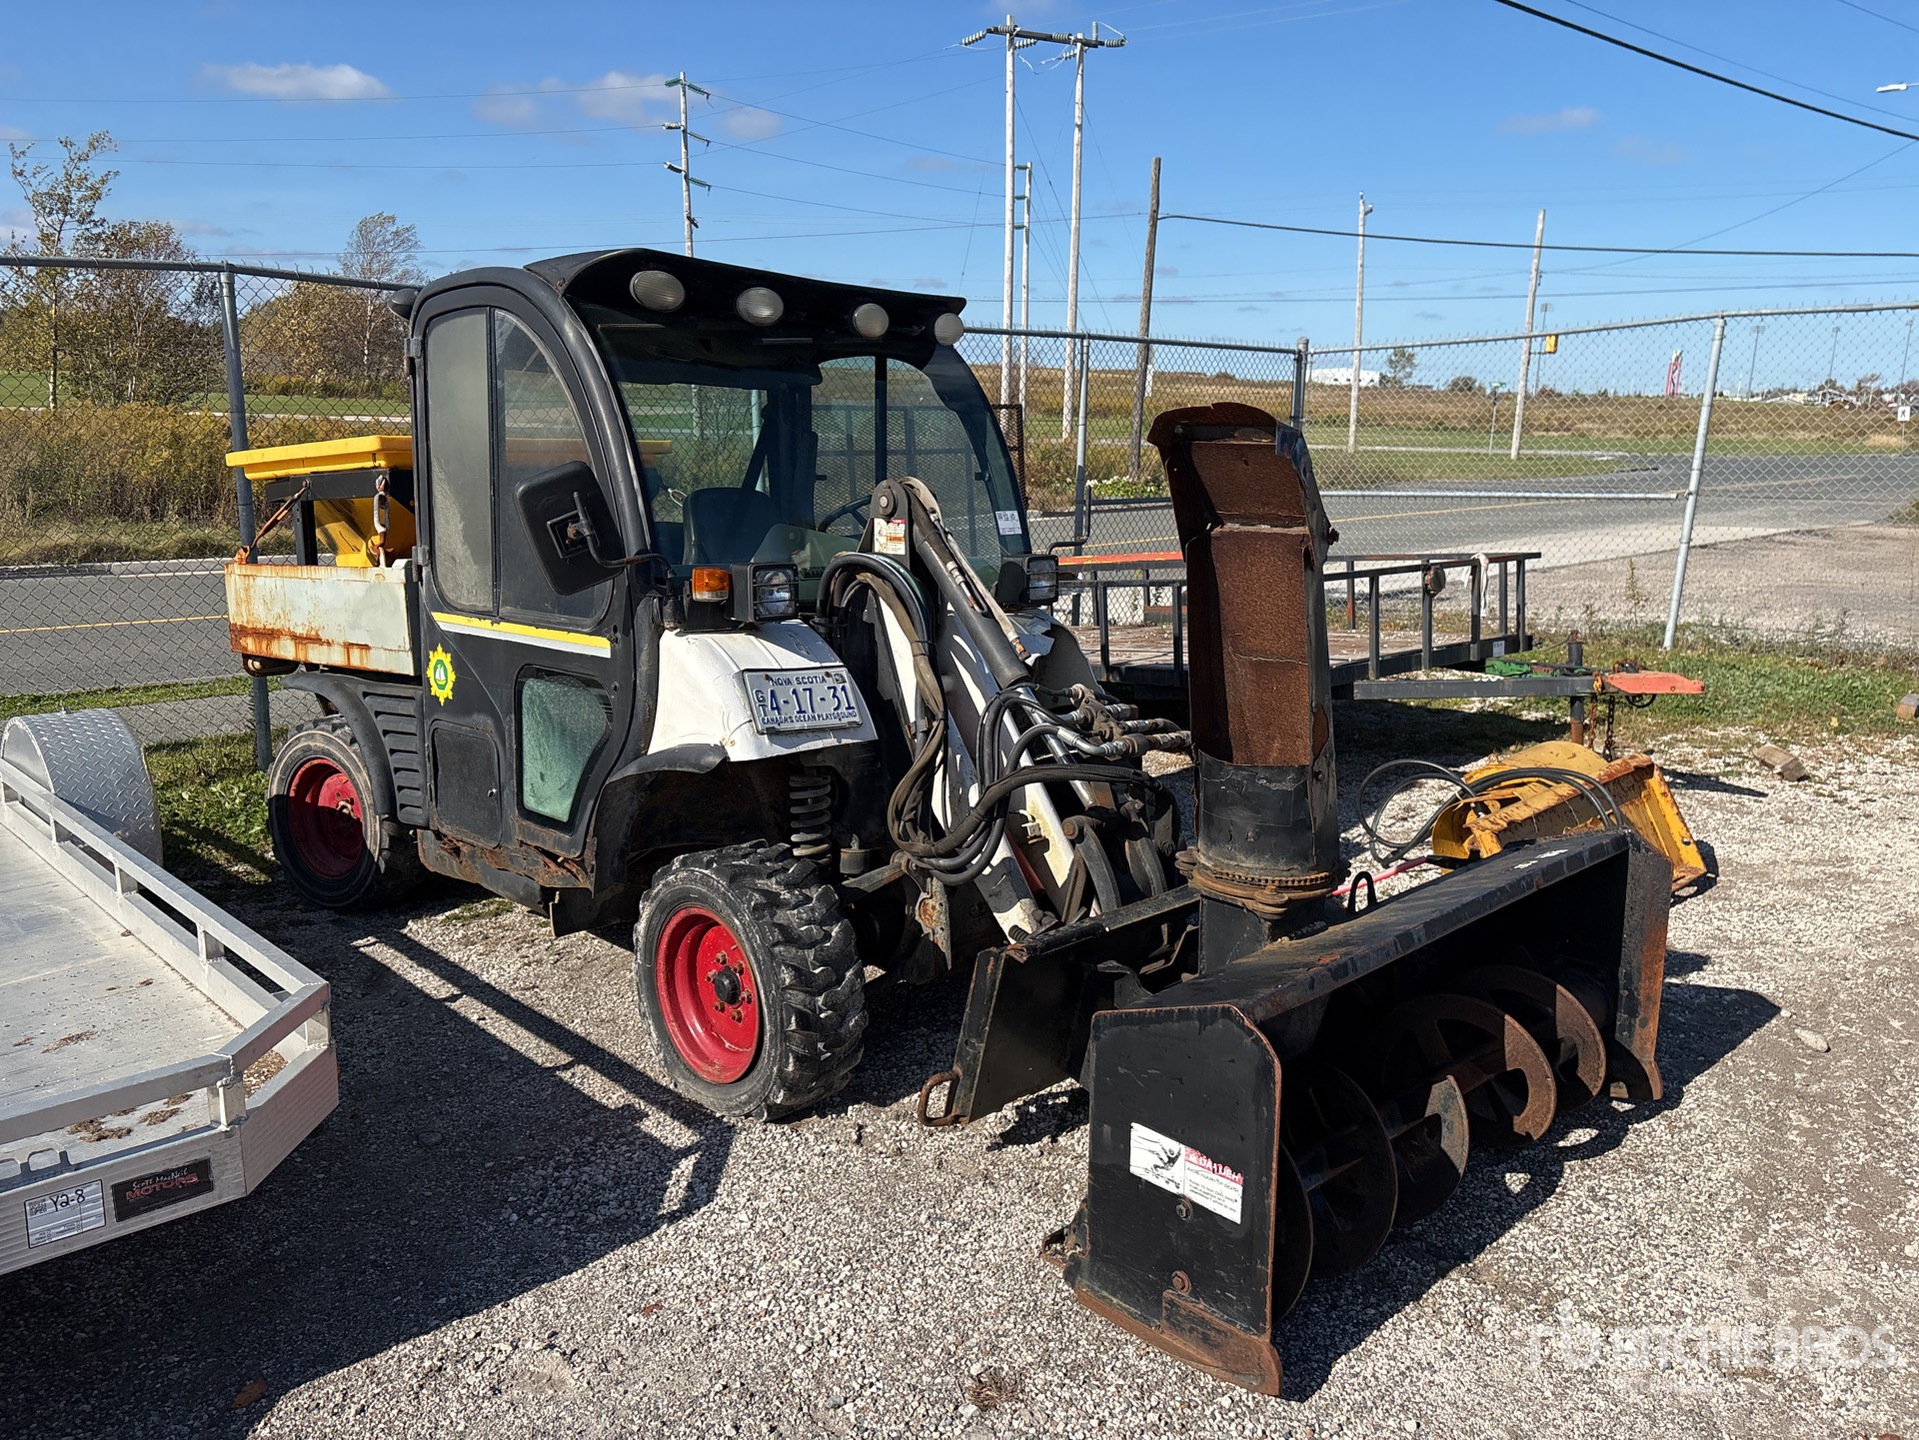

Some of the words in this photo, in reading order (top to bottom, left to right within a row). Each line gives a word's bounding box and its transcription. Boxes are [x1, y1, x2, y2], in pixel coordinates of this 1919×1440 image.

[771, 677, 793, 687] NOVA
[795, 674, 828, 685] SCOTIA
[768, 684, 856, 717] 4-17-31
[761, 714, 795, 726] CANADA'S
[794, 713, 818, 724] OCEAN
[816, 711, 858, 722] PLAYGROUND
[126, 1173, 200, 1200] MOTORS
[133, 1178, 153, 1190] Scott
[155, 1167, 189, 1184] MacNeil
[49, 1186, 85, 1212] Y2-8
